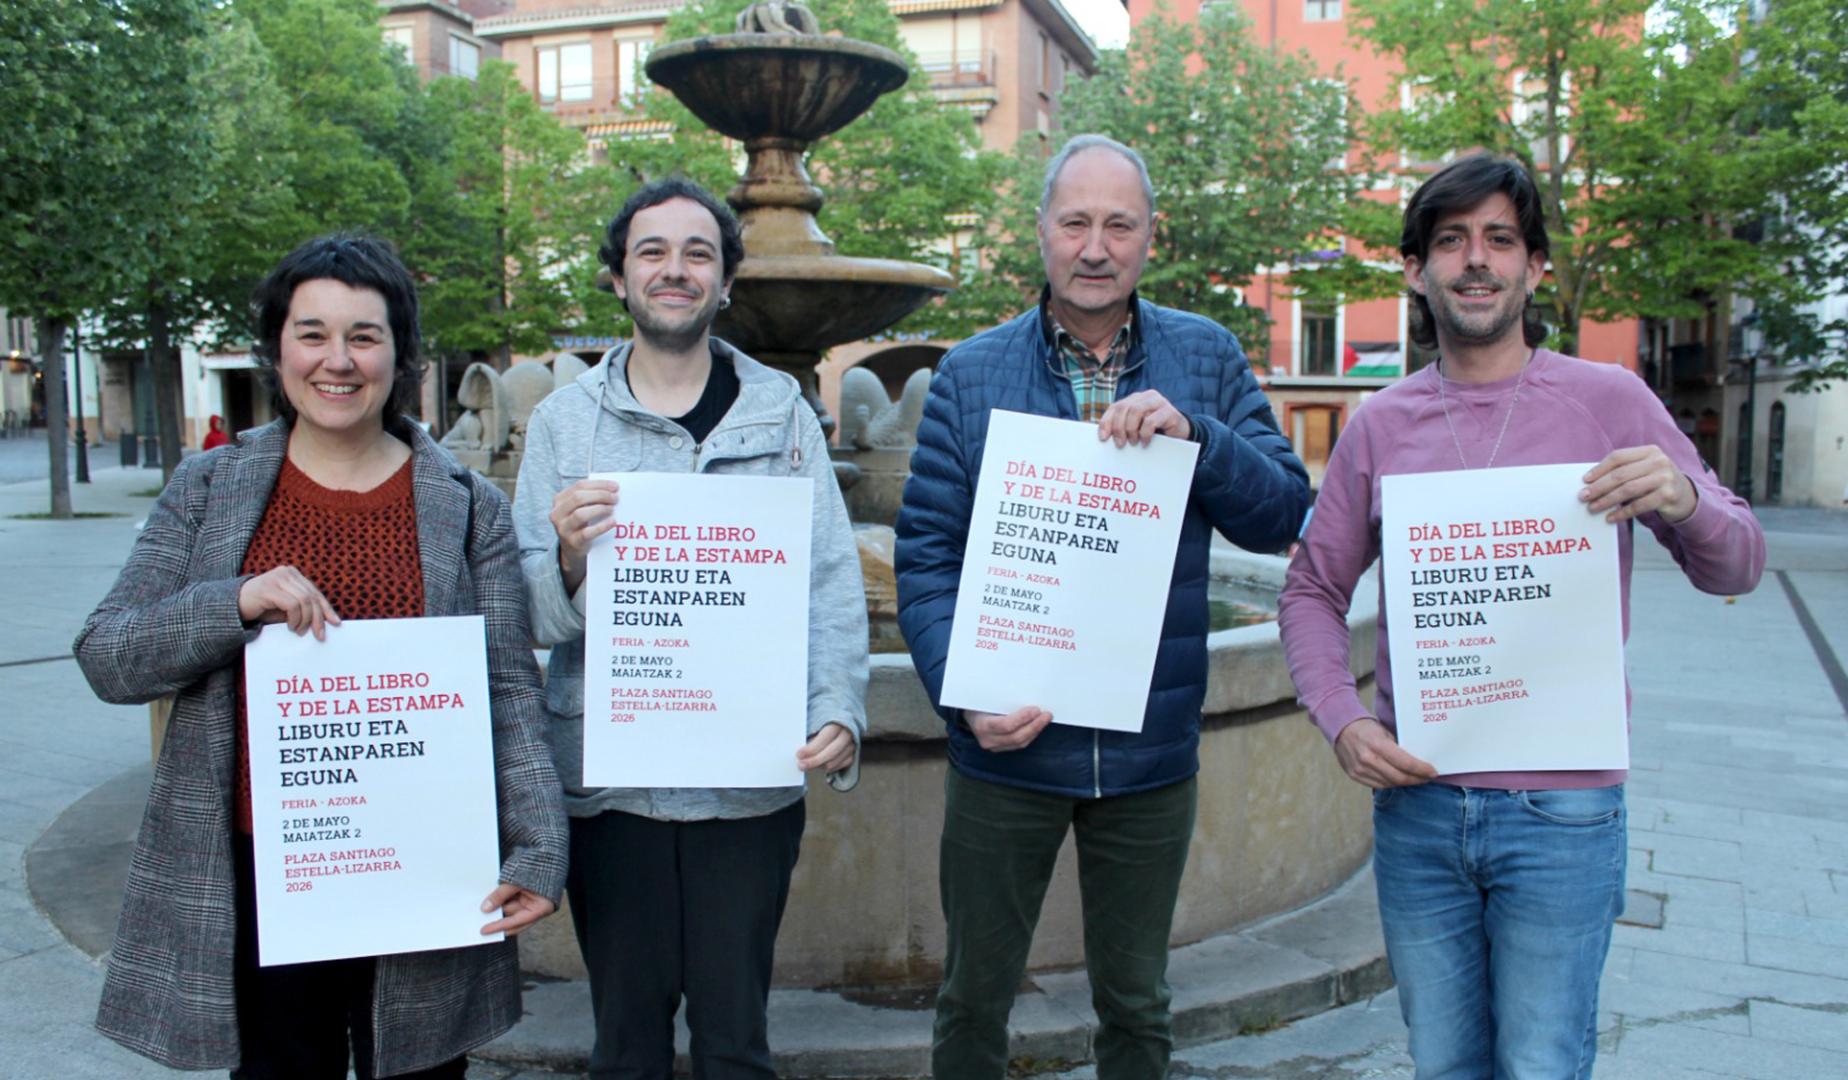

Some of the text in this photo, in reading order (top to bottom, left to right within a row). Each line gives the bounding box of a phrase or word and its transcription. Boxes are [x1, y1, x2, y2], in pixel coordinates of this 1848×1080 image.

[1006, 461, 1137, 494] DÍA DEL LIBRO
[1003, 481, 1161, 519] Y DE LA ESTAMPA
[998, 501, 1108, 532] LIBURU ETA
[614, 522, 756, 542] DÍA DEL LIBRO
[995, 521, 1119, 554] ESTANPAREN
[1409, 518, 1555, 542] DÍA DEL LIBRO
[614, 546, 787, 564] Y DE LA ESTAMPA
[991, 542, 1057, 565] EGUNA
[1410, 537, 1592, 563] Y DE LA ESTAMPA
[614, 568, 732, 584] LIBURU ETA
[987, 567, 1018, 580] FERIA
[1026, 573, 1060, 586] AZOKA
[1411, 564, 1535, 586] LIBURU ETA
[613, 590, 746, 606] ESTANPAREN
[984, 584, 1043, 601] 2 DE MAYO
[1413, 584, 1551, 608] ESTANPAREN
[982, 596, 1050, 615] MAIATZAK 2
[613, 611, 683, 627] EGUNA
[979, 615, 1074, 638] PLAZA SANTIAGO
[1414, 611, 1487, 629] EGUNA
[612, 637, 644, 647] FERIA
[654, 638, 690, 648] AZOKA
[975, 639, 999, 651] 2026
[977, 627, 1077, 651] ESTELLA-LIZARRA
[1416, 640, 1449, 649] FERIA
[1459, 636, 1496, 647] AZOKA
[612, 656, 673, 666] 2 DE MAYO
[1418, 655, 1480, 667] 2 DE MAYO
[611, 668, 683, 679] MAIATZAK 2
[1419, 665, 1492, 681] MAIATZAK 2
[276, 672, 429, 695] DÍA DEL LIBRO
[1421, 679, 1523, 699] PLAZA SANTIAGO
[611, 688, 713, 699] PLAZA SANTIAGO
[1422, 689, 1529, 712] ESTELLA-LIZARRA
[277, 693, 464, 718] Y DE LA ESTAMPA
[611, 701, 717, 712] ESTELLA-LIZARRA
[610, 713, 635, 723] 2026
[1423, 712, 1447, 723] 2026
[278, 719, 408, 741] LIBURU ETA
[279, 741, 425, 764] ESTANPAREN
[281, 768, 358, 787] EGUNA
[281, 799, 317, 809] FERIA
[327, 795, 367, 806] AZOKA
[283, 816, 350, 829] 2 DE MAYO
[283, 829, 361, 843] MAIATZAK 2
[284, 847, 395, 864] PLAZA SANTIAGO
[285, 861, 402, 879] ESTELLA-LIZARRA
[286, 881, 313, 892] 2026
